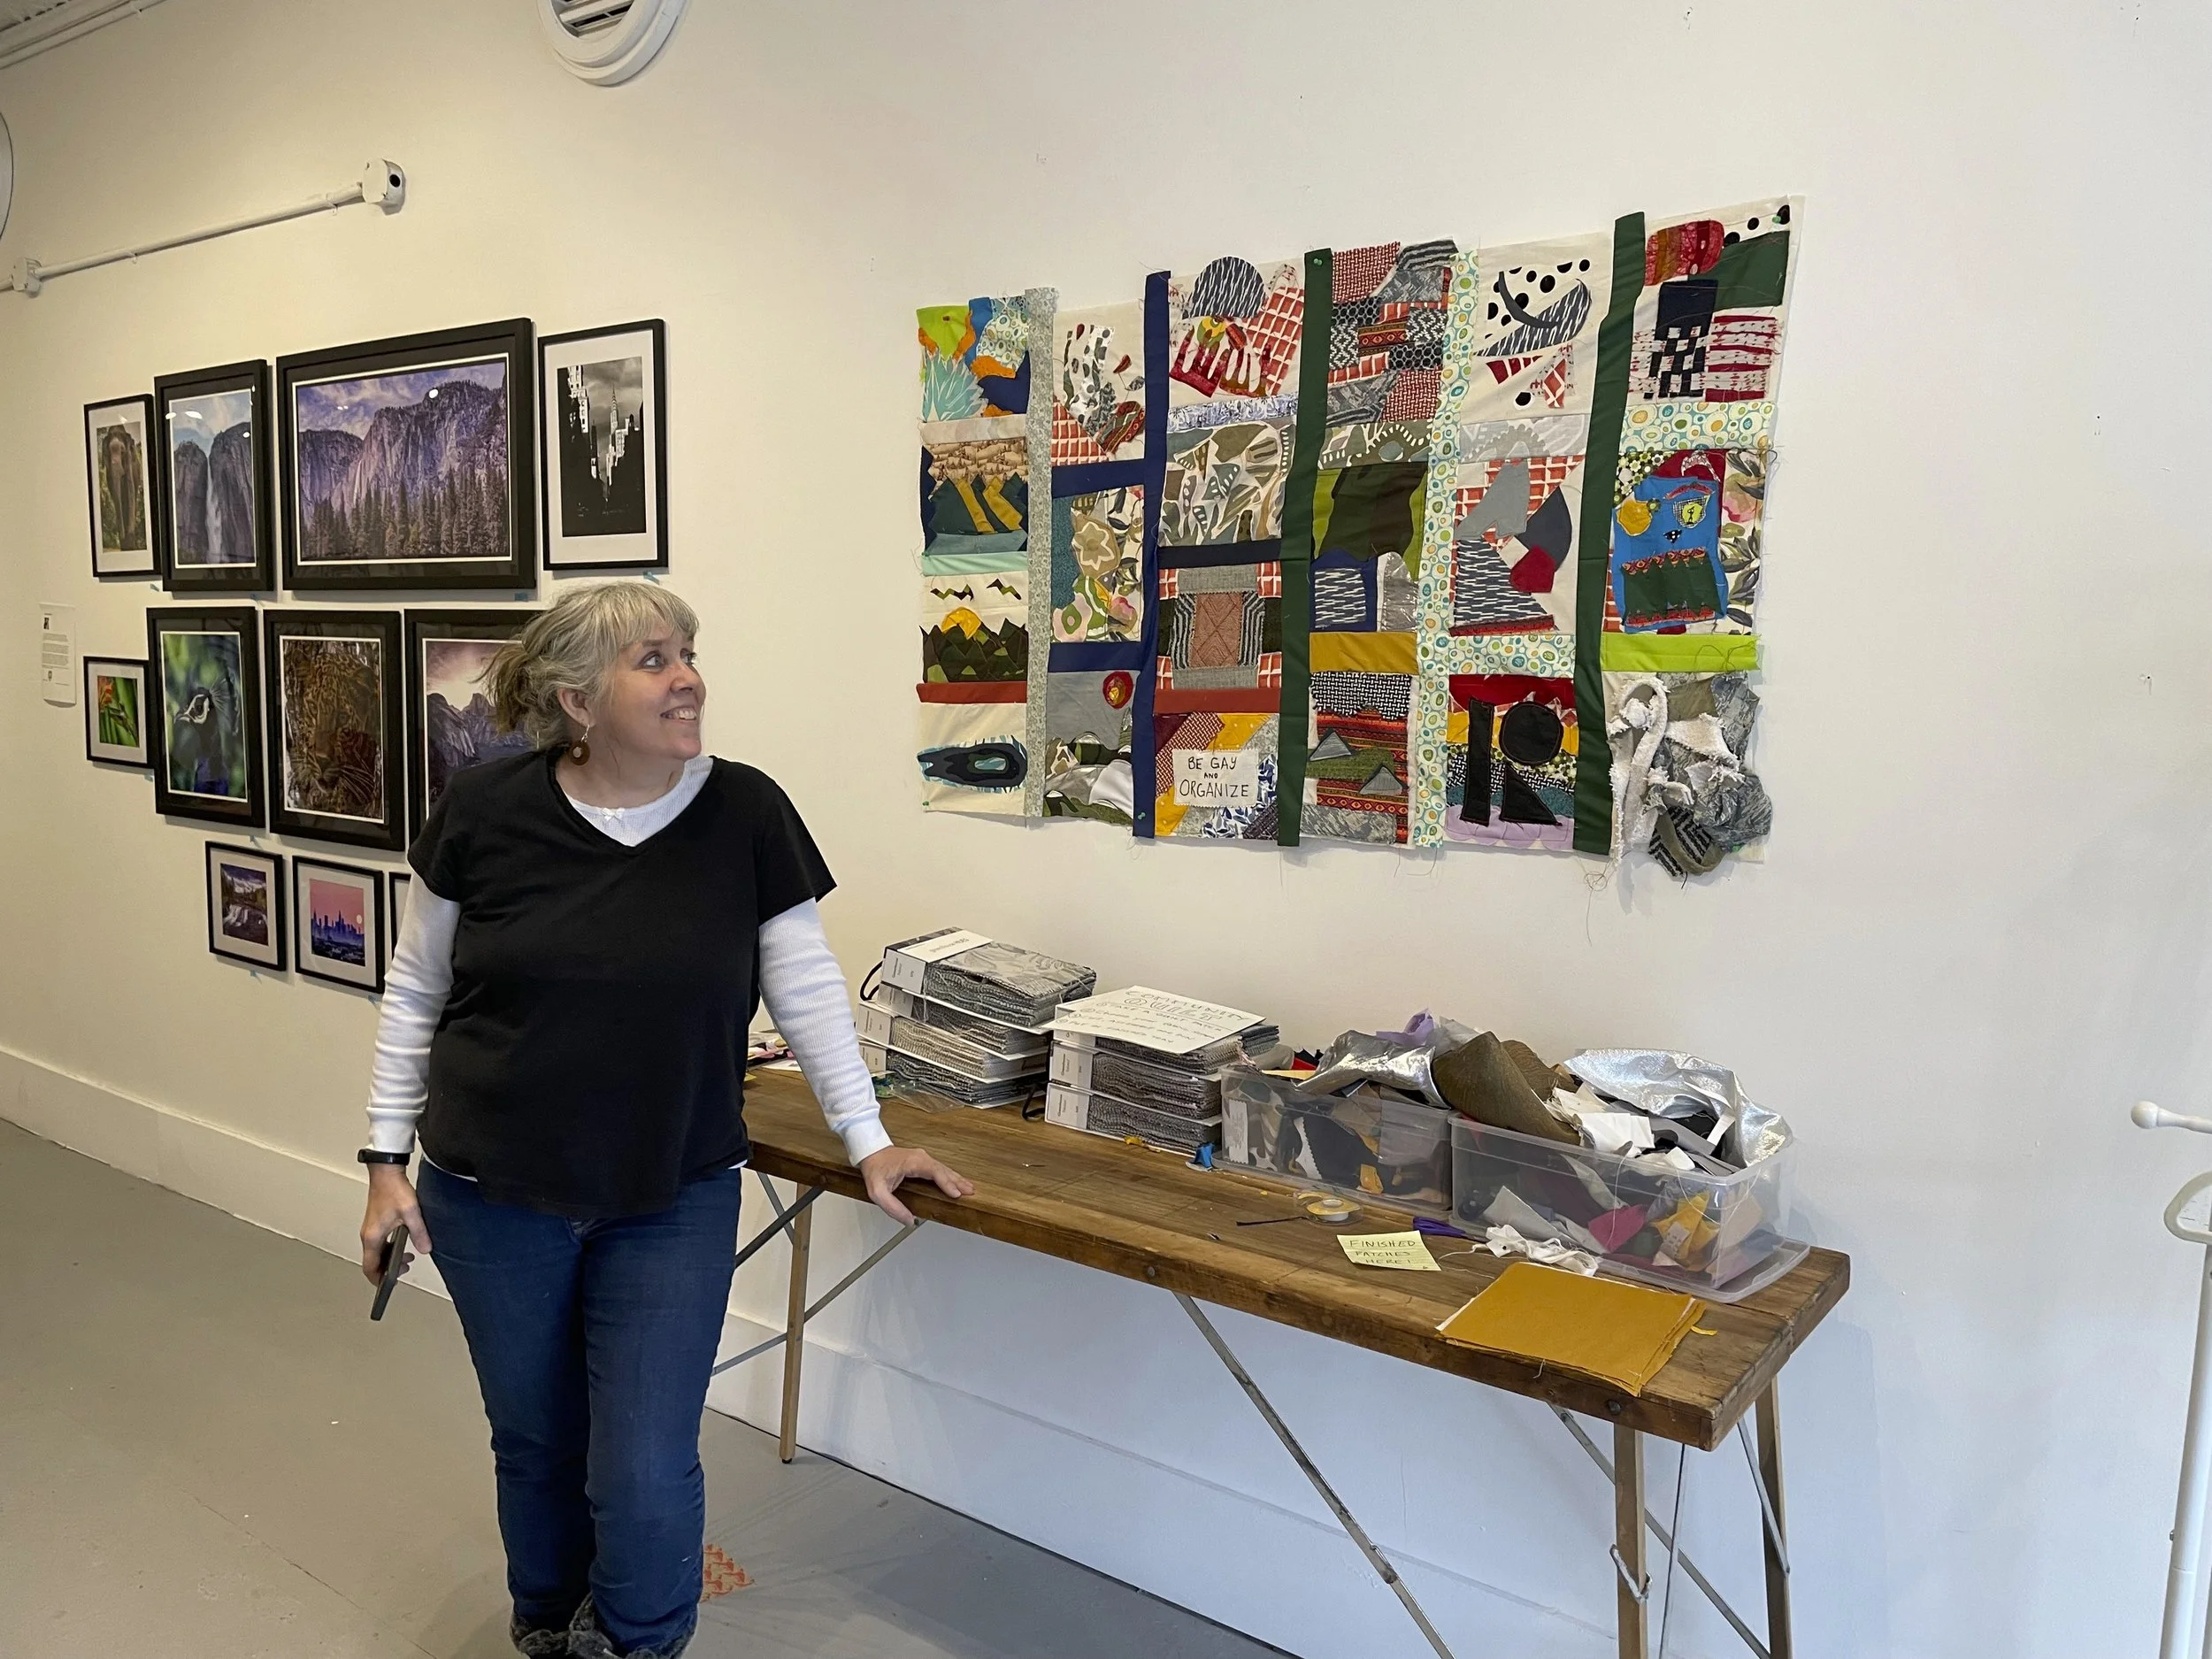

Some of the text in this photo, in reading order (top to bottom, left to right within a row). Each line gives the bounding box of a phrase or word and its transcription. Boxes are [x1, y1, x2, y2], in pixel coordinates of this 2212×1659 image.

[1187, 756, 1237, 770] BE GAY
[1179, 779, 1249, 798] ORGANIZE
[1124, 997, 1224, 1021] QUILT
[1125, 990, 1249, 1021] COMMUNITY
[1349, 1240, 1416, 1248] FINISHED
